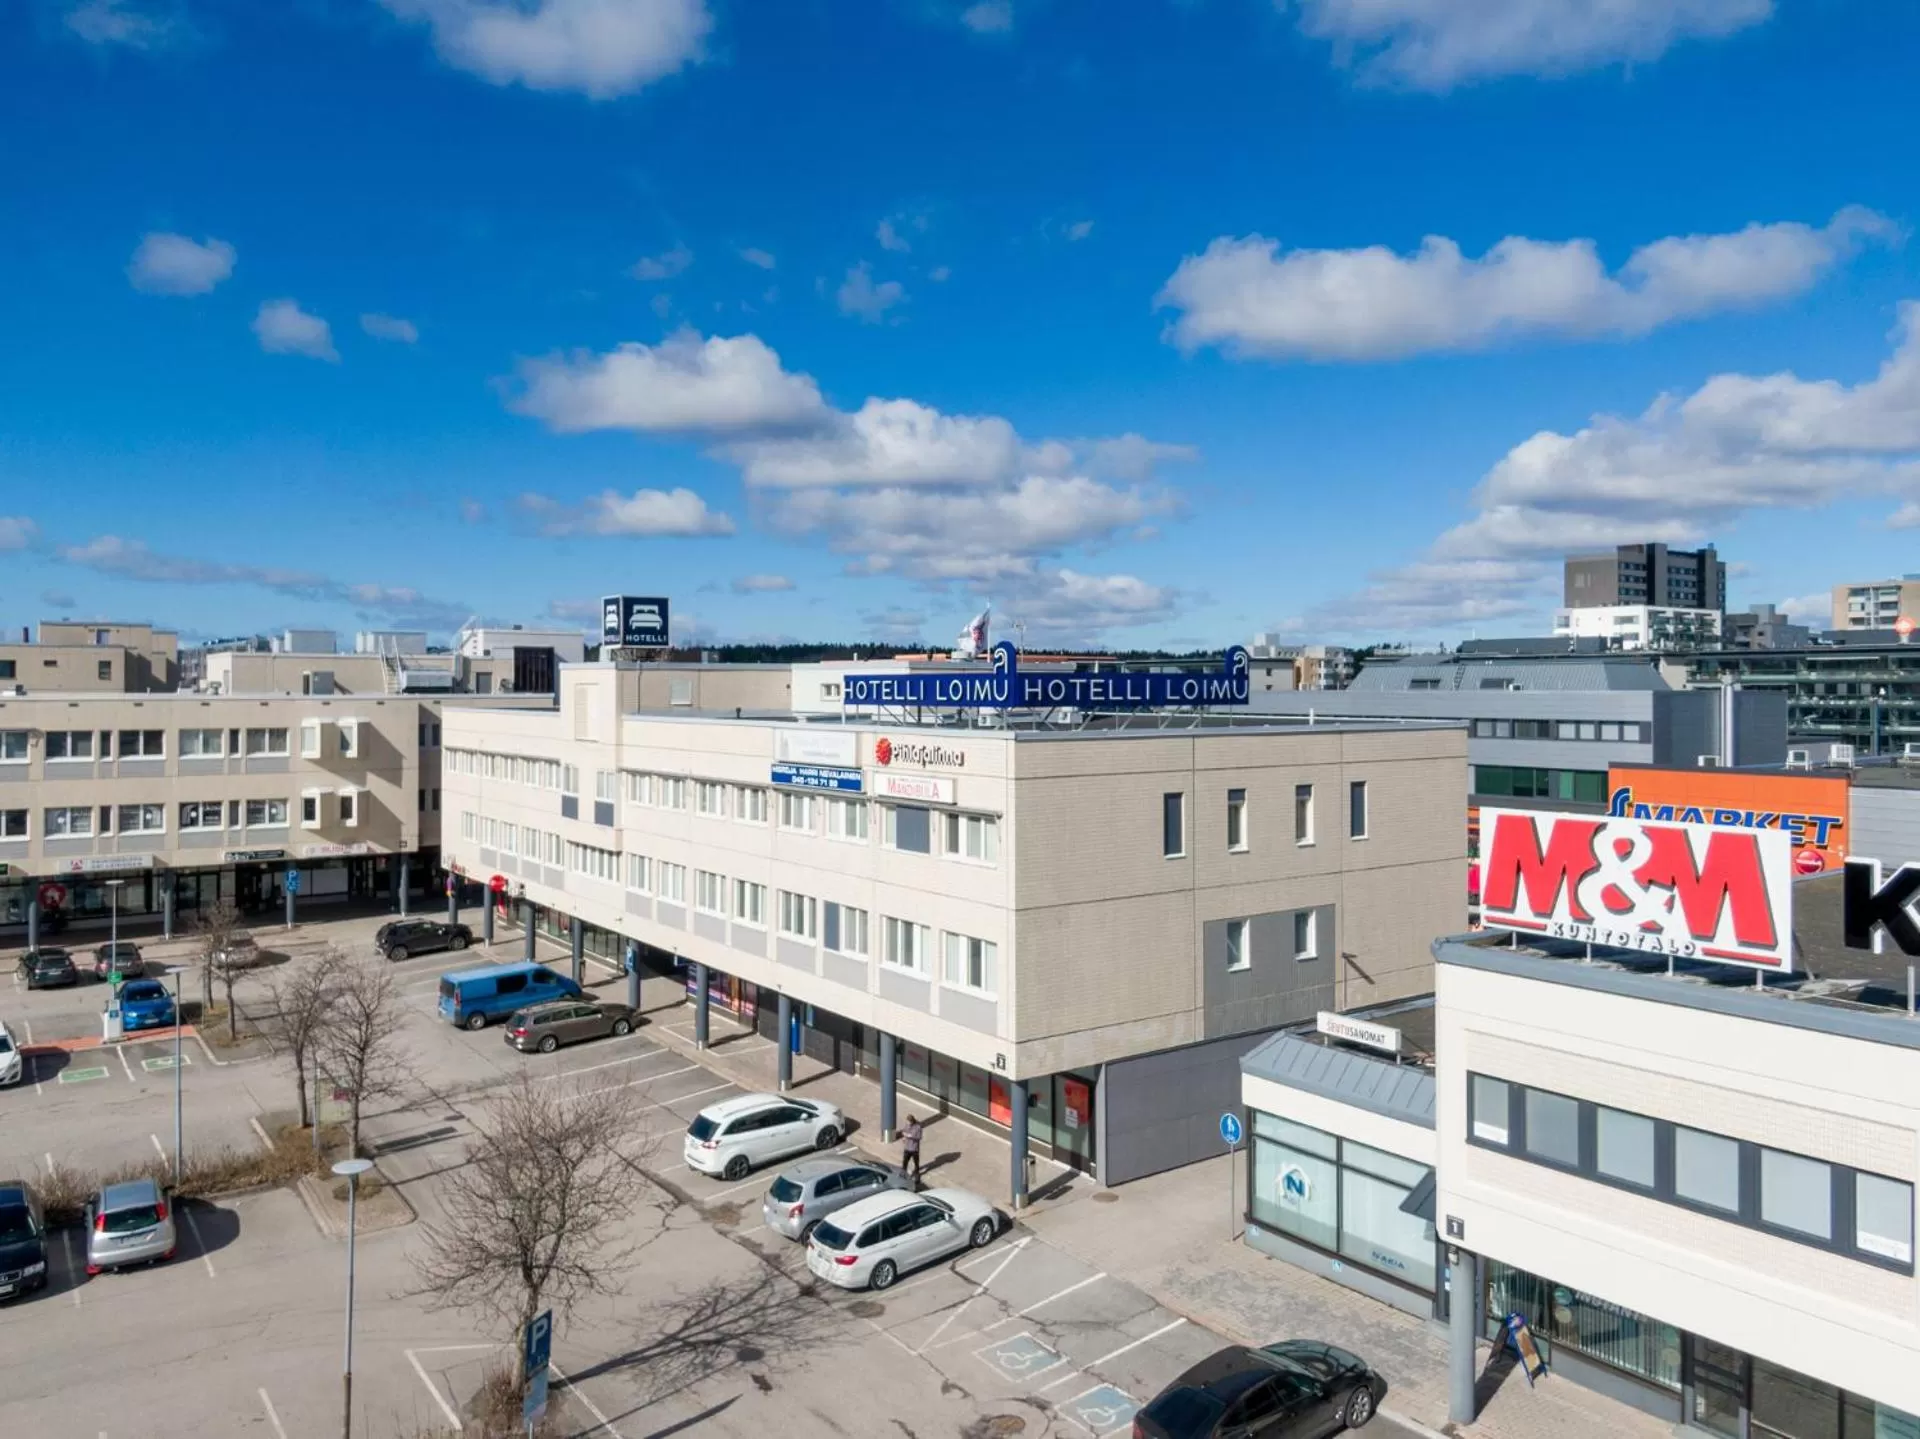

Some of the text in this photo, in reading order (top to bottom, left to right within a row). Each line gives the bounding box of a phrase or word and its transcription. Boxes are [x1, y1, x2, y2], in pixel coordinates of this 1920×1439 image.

[625, 634, 667, 643] HOTELLI
[842, 679, 1008, 701] HOTELLI LOIMU
[1024, 679, 1248, 701] HOTELLI LOIMU
[1482, 814, 1777, 948] M&M
[1552, 921, 1697, 956] KUNTOTALO
[532, 1317, 548, 1354] P
